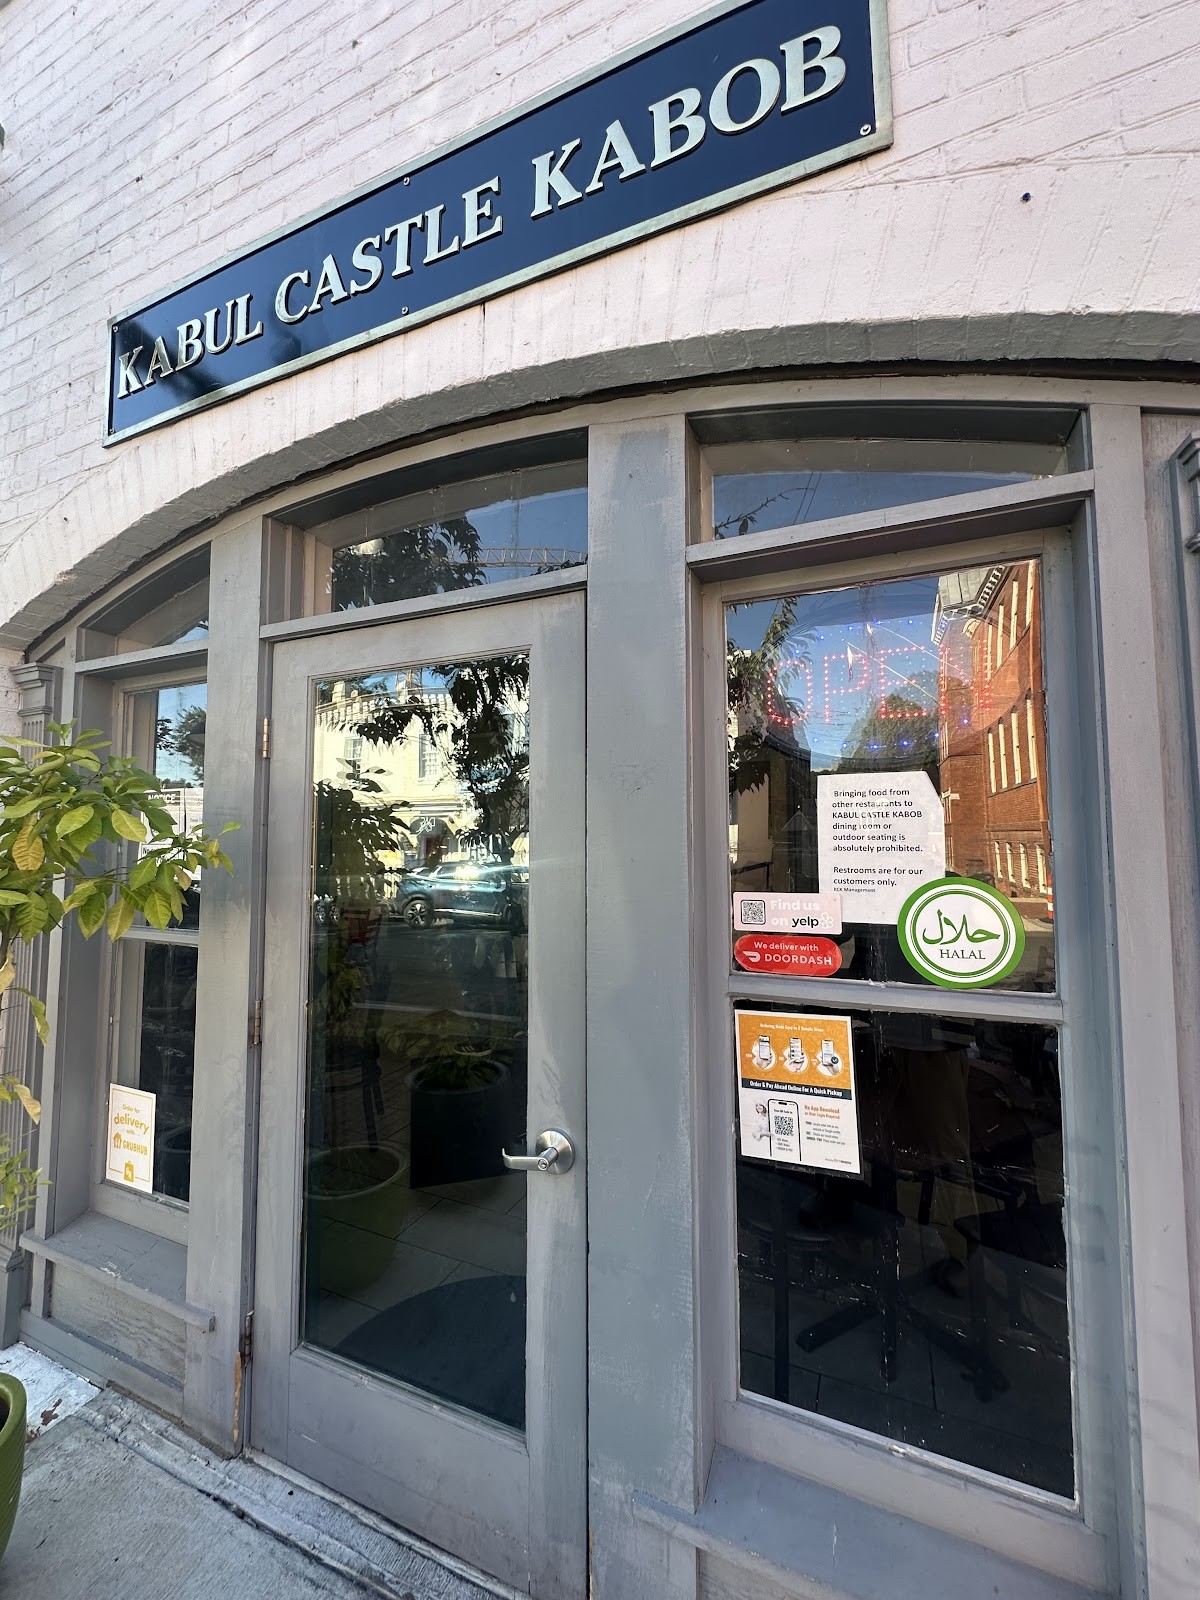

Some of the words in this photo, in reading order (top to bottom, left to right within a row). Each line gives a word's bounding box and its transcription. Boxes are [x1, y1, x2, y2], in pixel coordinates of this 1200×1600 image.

[117, 292, 263, 400] KABUL
[274, 175, 503, 325] CASTLE
[530, 25, 846, 221] KABOB
[833, 790, 867, 798] Bringing
[889, 788, 910, 796] from
[856, 800, 901, 808] restaurants
[832, 811, 859, 819] KABUL
[861, 811, 890, 819] CASTLE
[832, 823, 857, 831] dining
[832, 833, 865, 841] outdoor
[867, 833, 897, 842] seating
[899, 833, 906, 841] is
[832, 844, 875, 853] absolutely
[876, 844, 923, 853] prohibited.
[833, 866, 876, 874] Restrooms
[894, 867, 906, 875] for
[877, 878, 897, 887] only.
[771, 899, 801, 910] Find
[802, 902, 820, 911] us
[771, 918, 788, 926] on
[791, 916, 819, 929] yelp
[922, 909, 1001, 945] حلال
[754, 941, 767, 949] We
[769, 942, 798, 951] deliver
[800, 943, 819, 952] with
[764, 953, 832, 966] DOORDASH
[939, 948, 986, 960] HALAL
[749, 1080, 761, 1088] Order
[766, 1082, 774, 1090] Pay
[774, 1083, 788, 1091] Ahead
[788, 1084, 801, 1092] Online
[814, 1087, 826, 1096] Quick
[826, 1088, 842, 1097] Pickup
[114, 1112, 149, 1135] delivery
[122, 1140, 148, 1155] GRUBHUB
